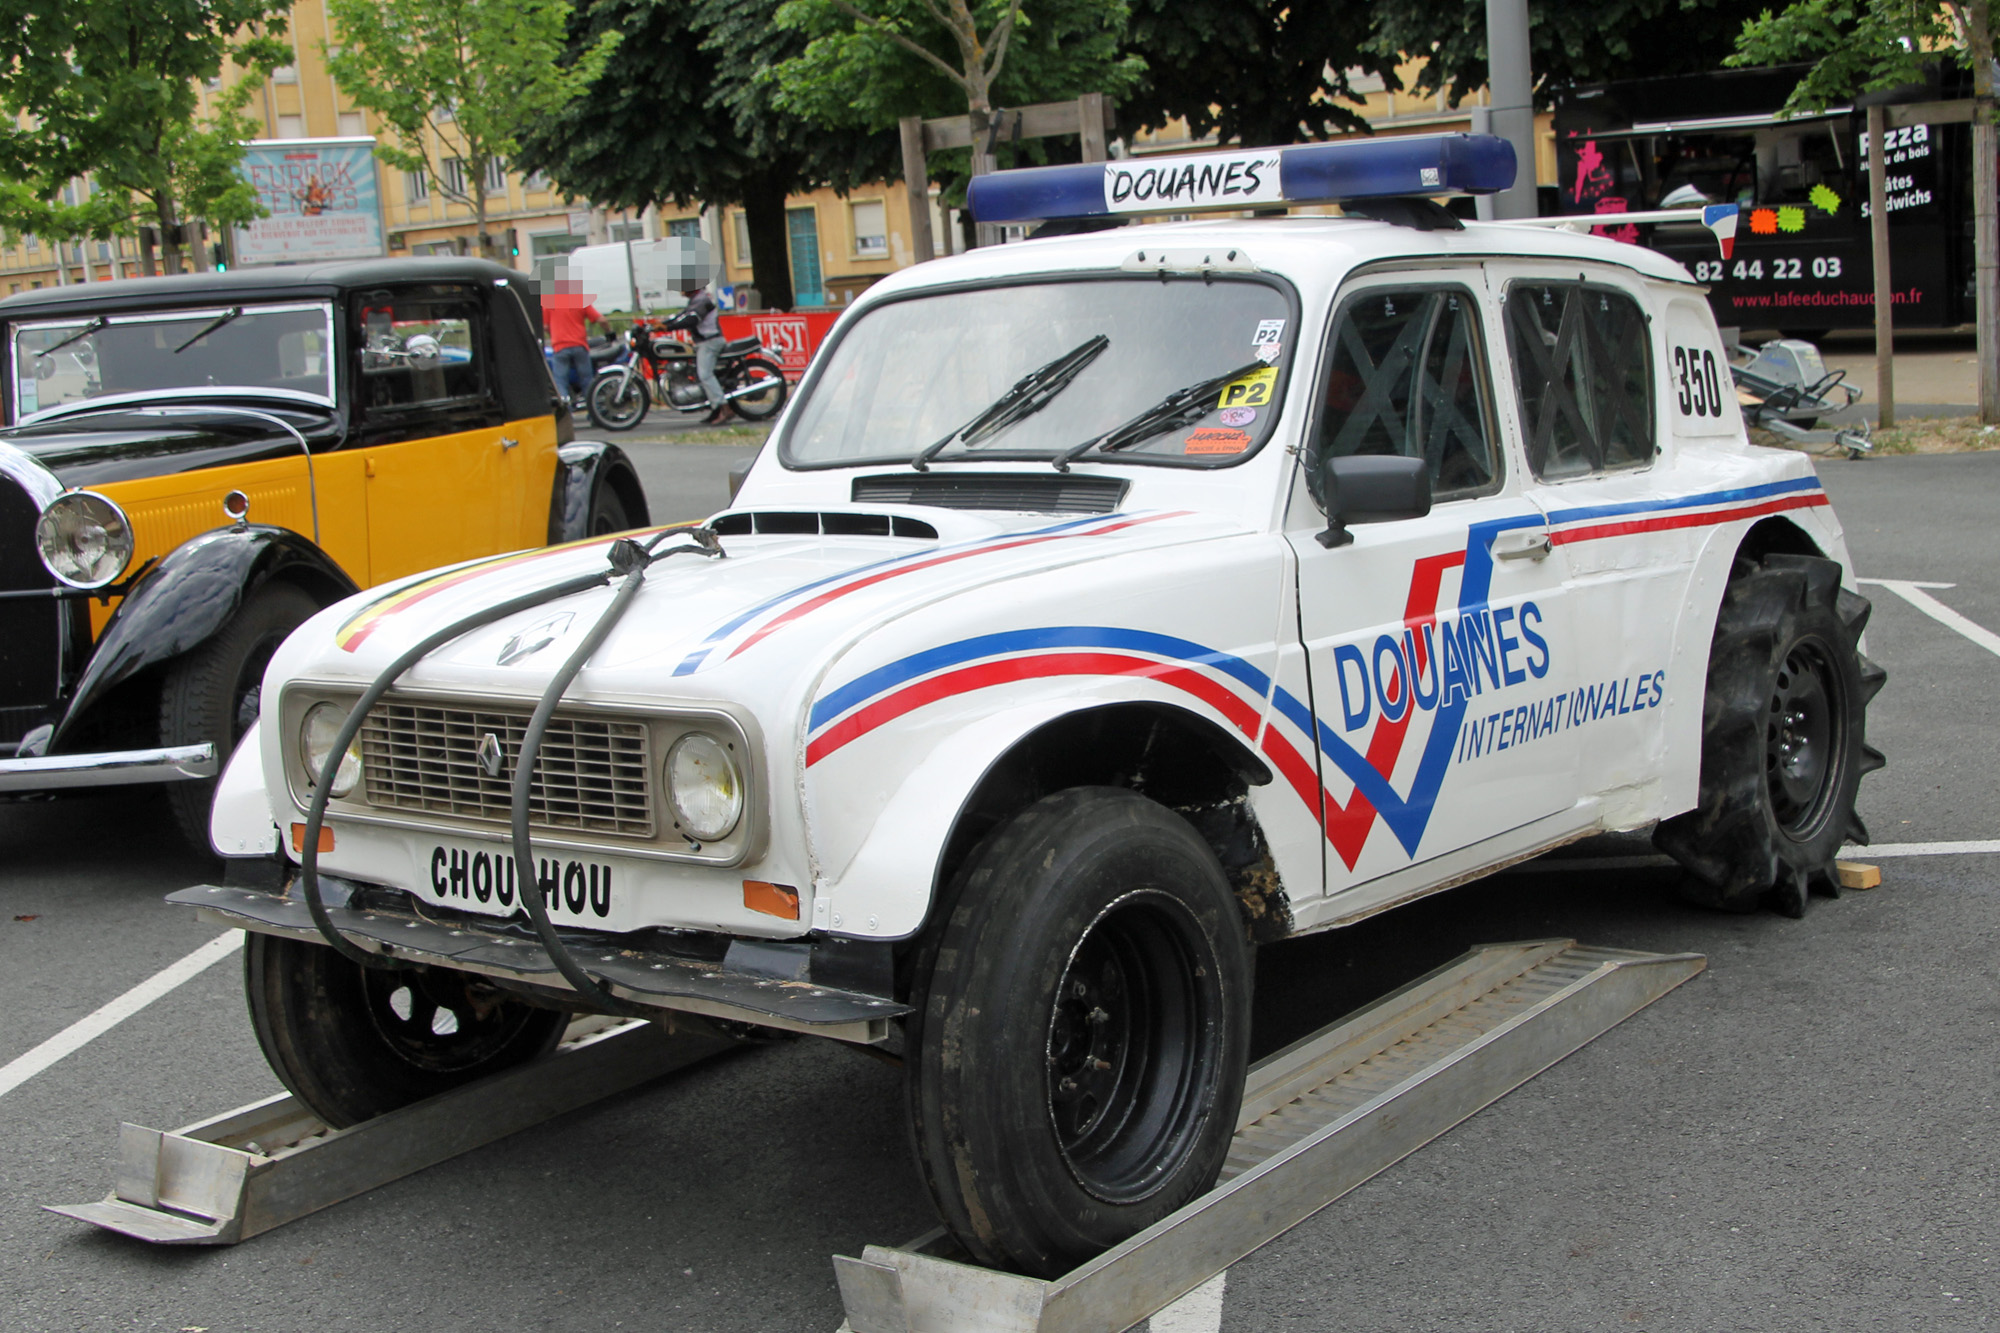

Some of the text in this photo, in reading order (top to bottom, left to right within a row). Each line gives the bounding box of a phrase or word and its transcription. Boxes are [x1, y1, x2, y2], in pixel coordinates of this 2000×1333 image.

[1859, 123, 1928, 157] Pzza
[1893, 150, 1906, 163] de
[1908, 144, 1930, 160] bois
[1884, 175, 1913, 192] âtes
[1696, 261, 1724, 281] 82
[1732, 260, 1764, 280] 44
[1773, 258, 1803, 279] 22
[1812, 257, 1842, 279] 03
[1256, 329, 1278, 343] P2
[1225, 382, 1267, 406] P2
[1675, 346, 1721, 417] 350
[1334, 601, 1549, 732] DOUANES
[1458, 669, 1665, 763] INTERNATIONALES
[431, 846, 611, 918] CHOUHOU
